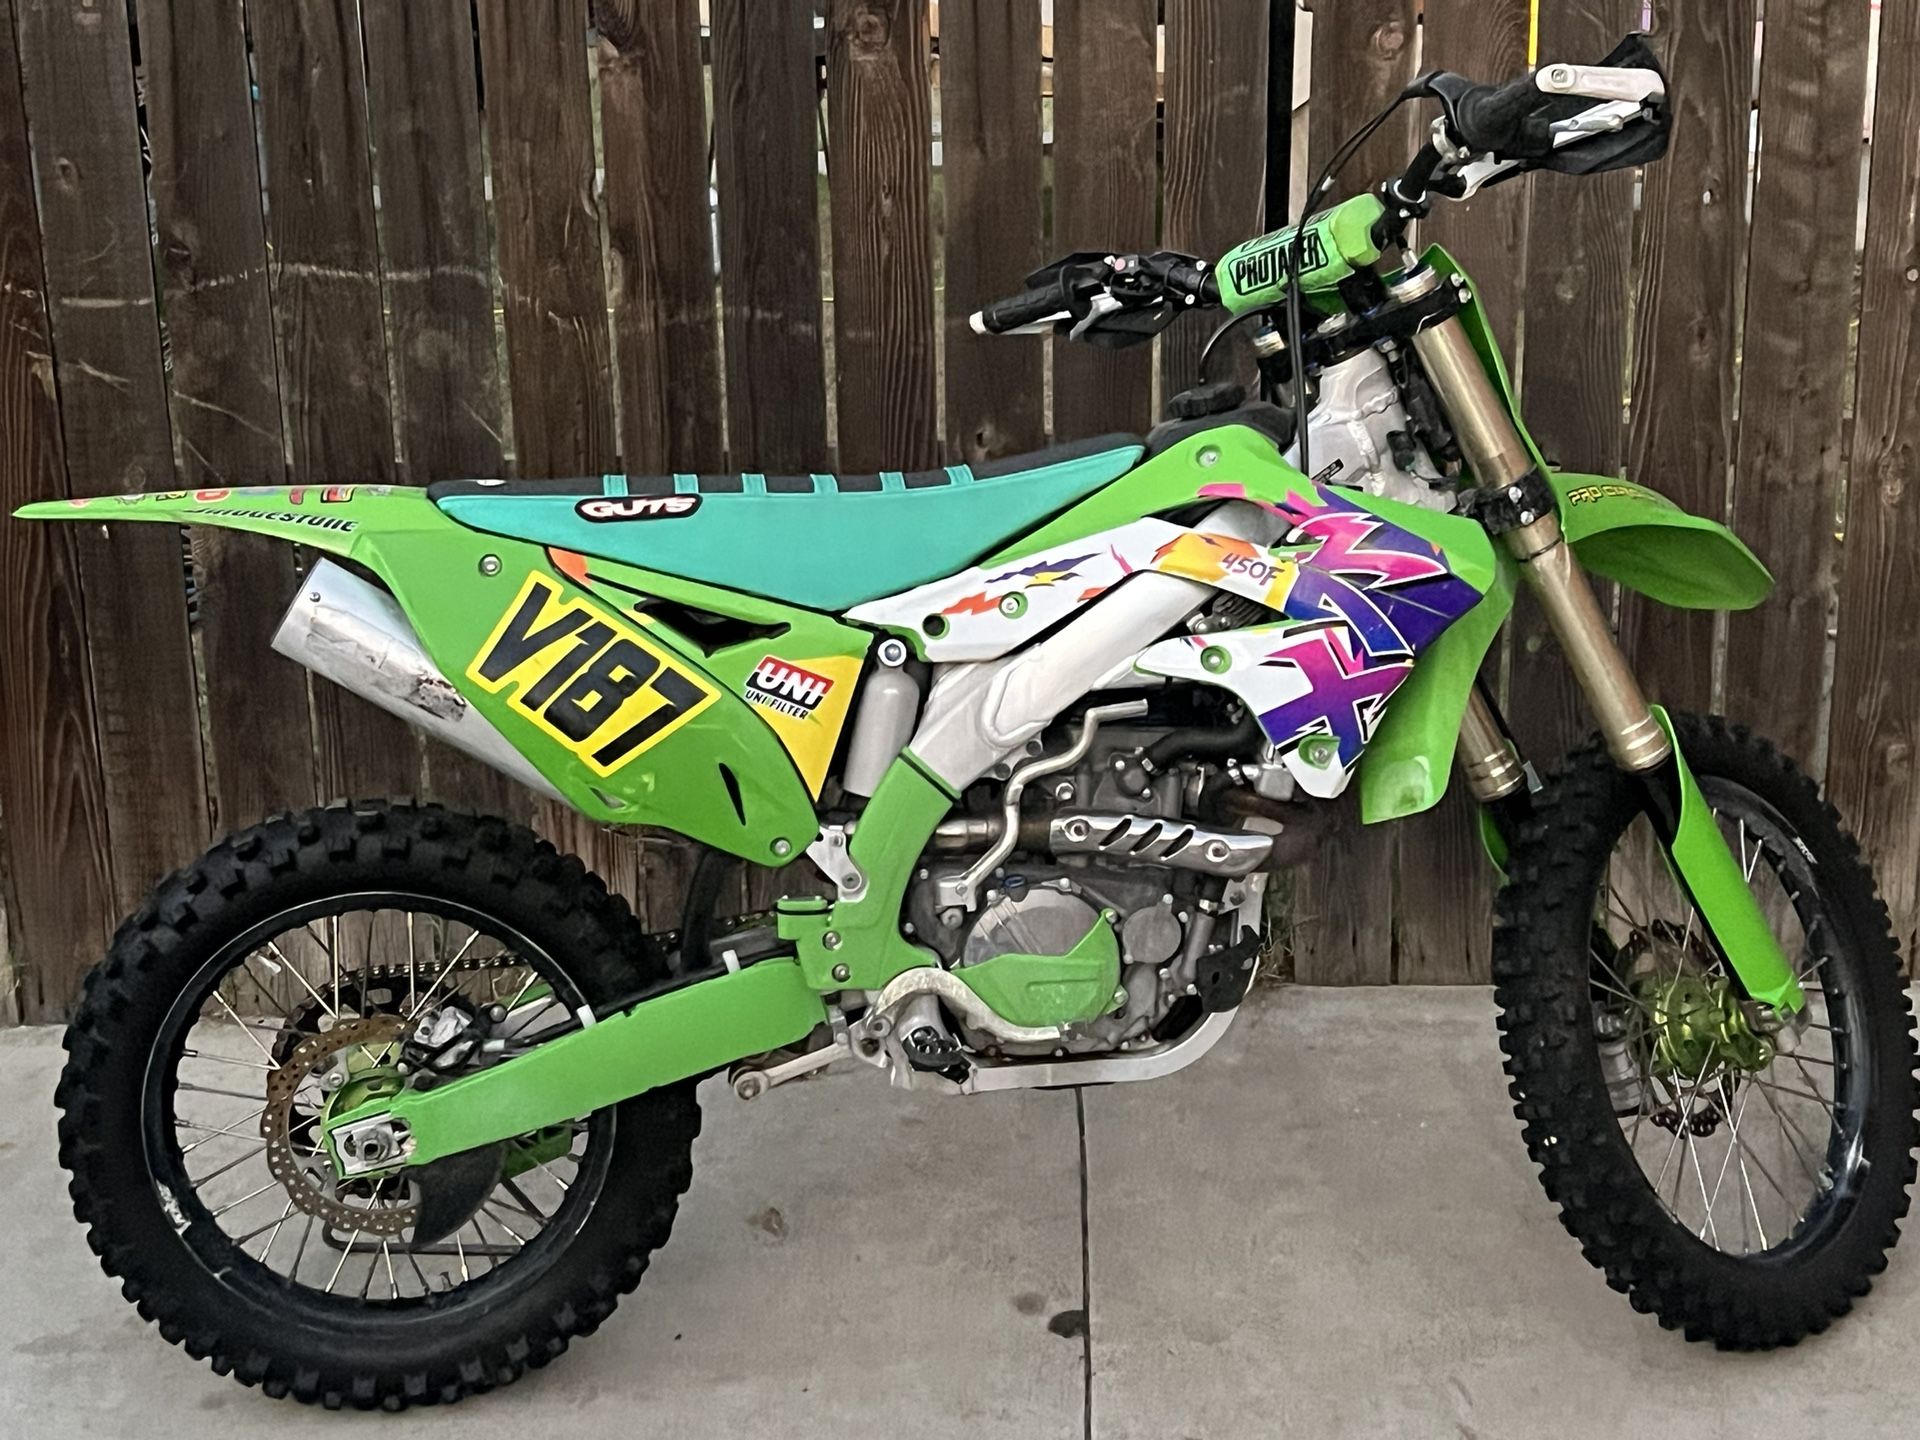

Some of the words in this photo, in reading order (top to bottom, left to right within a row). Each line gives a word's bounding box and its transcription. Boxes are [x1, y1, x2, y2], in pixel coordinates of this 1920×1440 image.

[1235, 230, 1321, 291] PROTAER
[580, 498, 696, 517] GUTS
[1567, 485, 1603, 505] PRO
[1222, 552, 1285, 586] 450F
[478, 581, 708, 767] V187
[757, 662, 826, 705] UNI
[745, 689, 768, 704] UNI
[769, 699, 808, 720] FILTER
